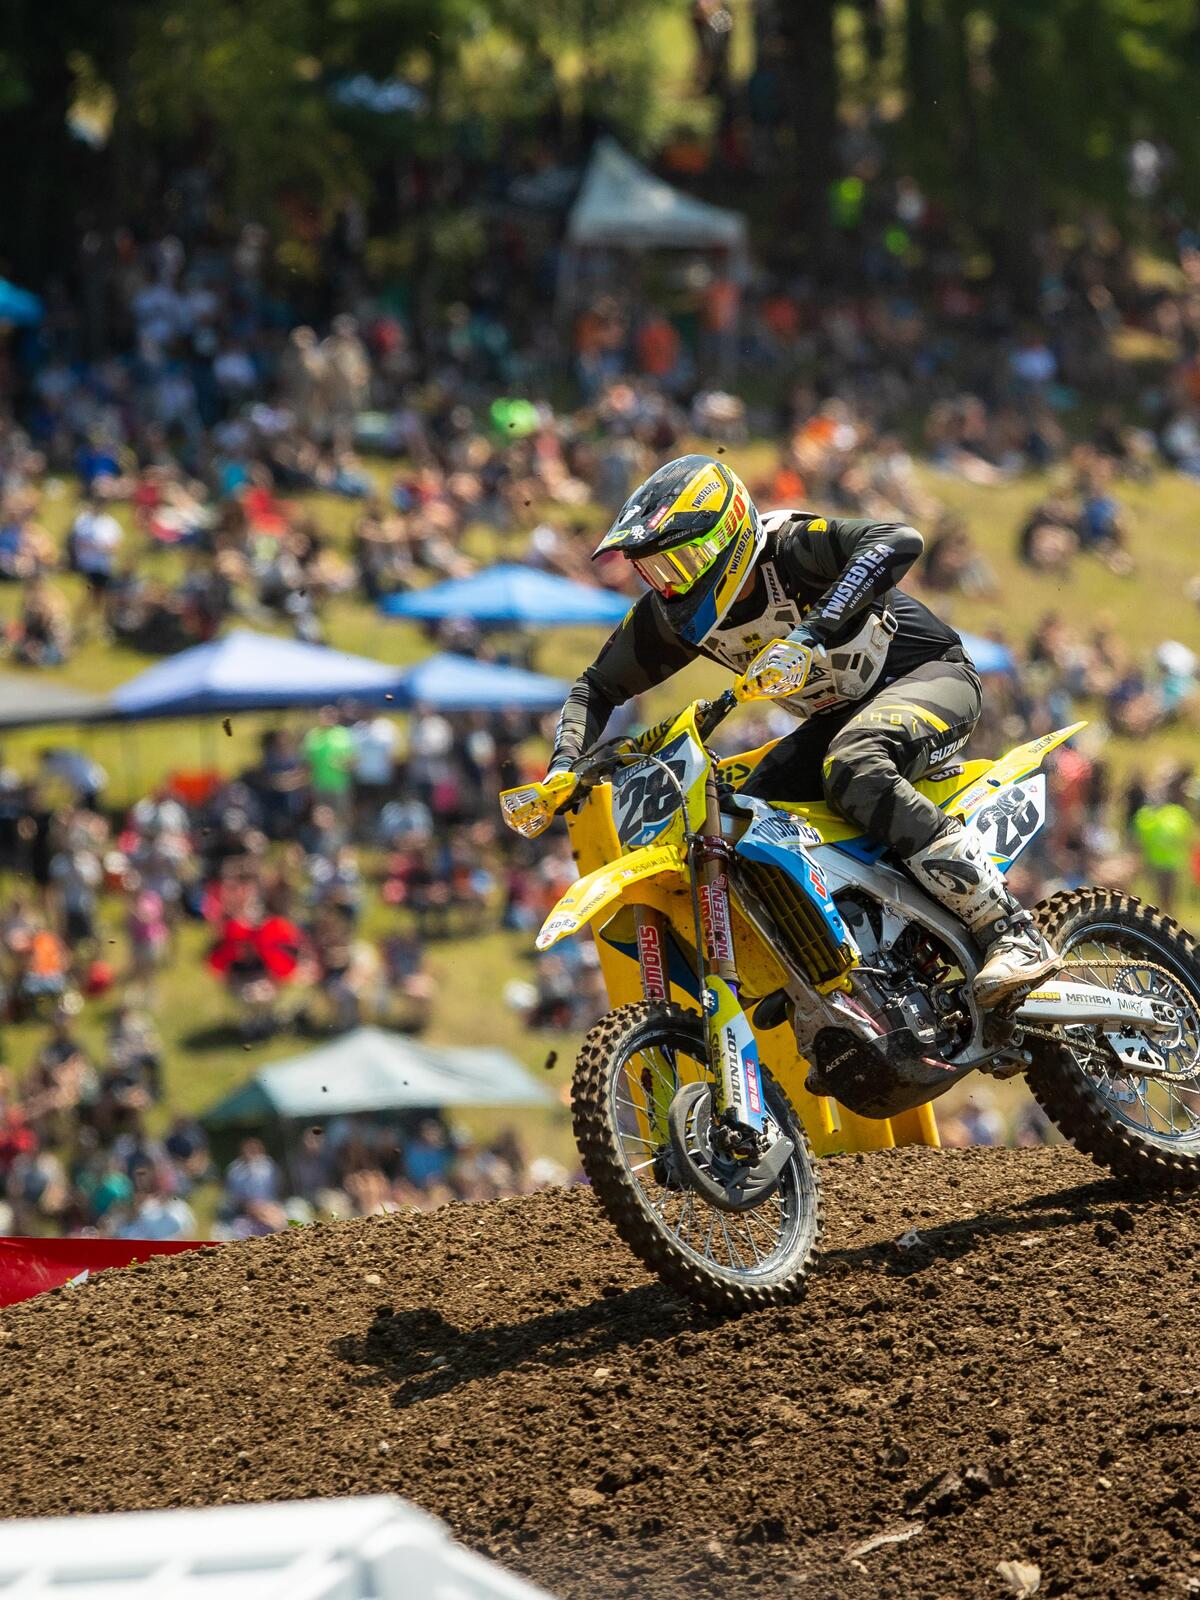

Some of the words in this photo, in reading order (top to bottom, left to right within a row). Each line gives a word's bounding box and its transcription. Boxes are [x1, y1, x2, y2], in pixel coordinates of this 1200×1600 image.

[691, 483, 711, 508] TWISTED
[728, 541, 747, 575] TWISTED
[742, 528, 753, 543] TEA
[766, 567, 782, 605] THOR
[821, 563, 869, 621] TWISTED
[856, 543, 896, 569] TEA
[849, 592, 864, 609] HARD
[862, 578, 875, 593] ICED
[873, 566, 886, 578] TEA
[626, 759, 647, 777] LUCAS
[929, 734, 970, 765] SUZUKI
[614, 759, 687, 842] 28
[976, 786, 1040, 857] 28
[711, 888, 729, 960] NOLEEN
[639, 925, 666, 1000] SHOWA
[1066, 993, 1112, 1006] MAYHEM
[727, 1027, 742, 1105] DUNLOP
